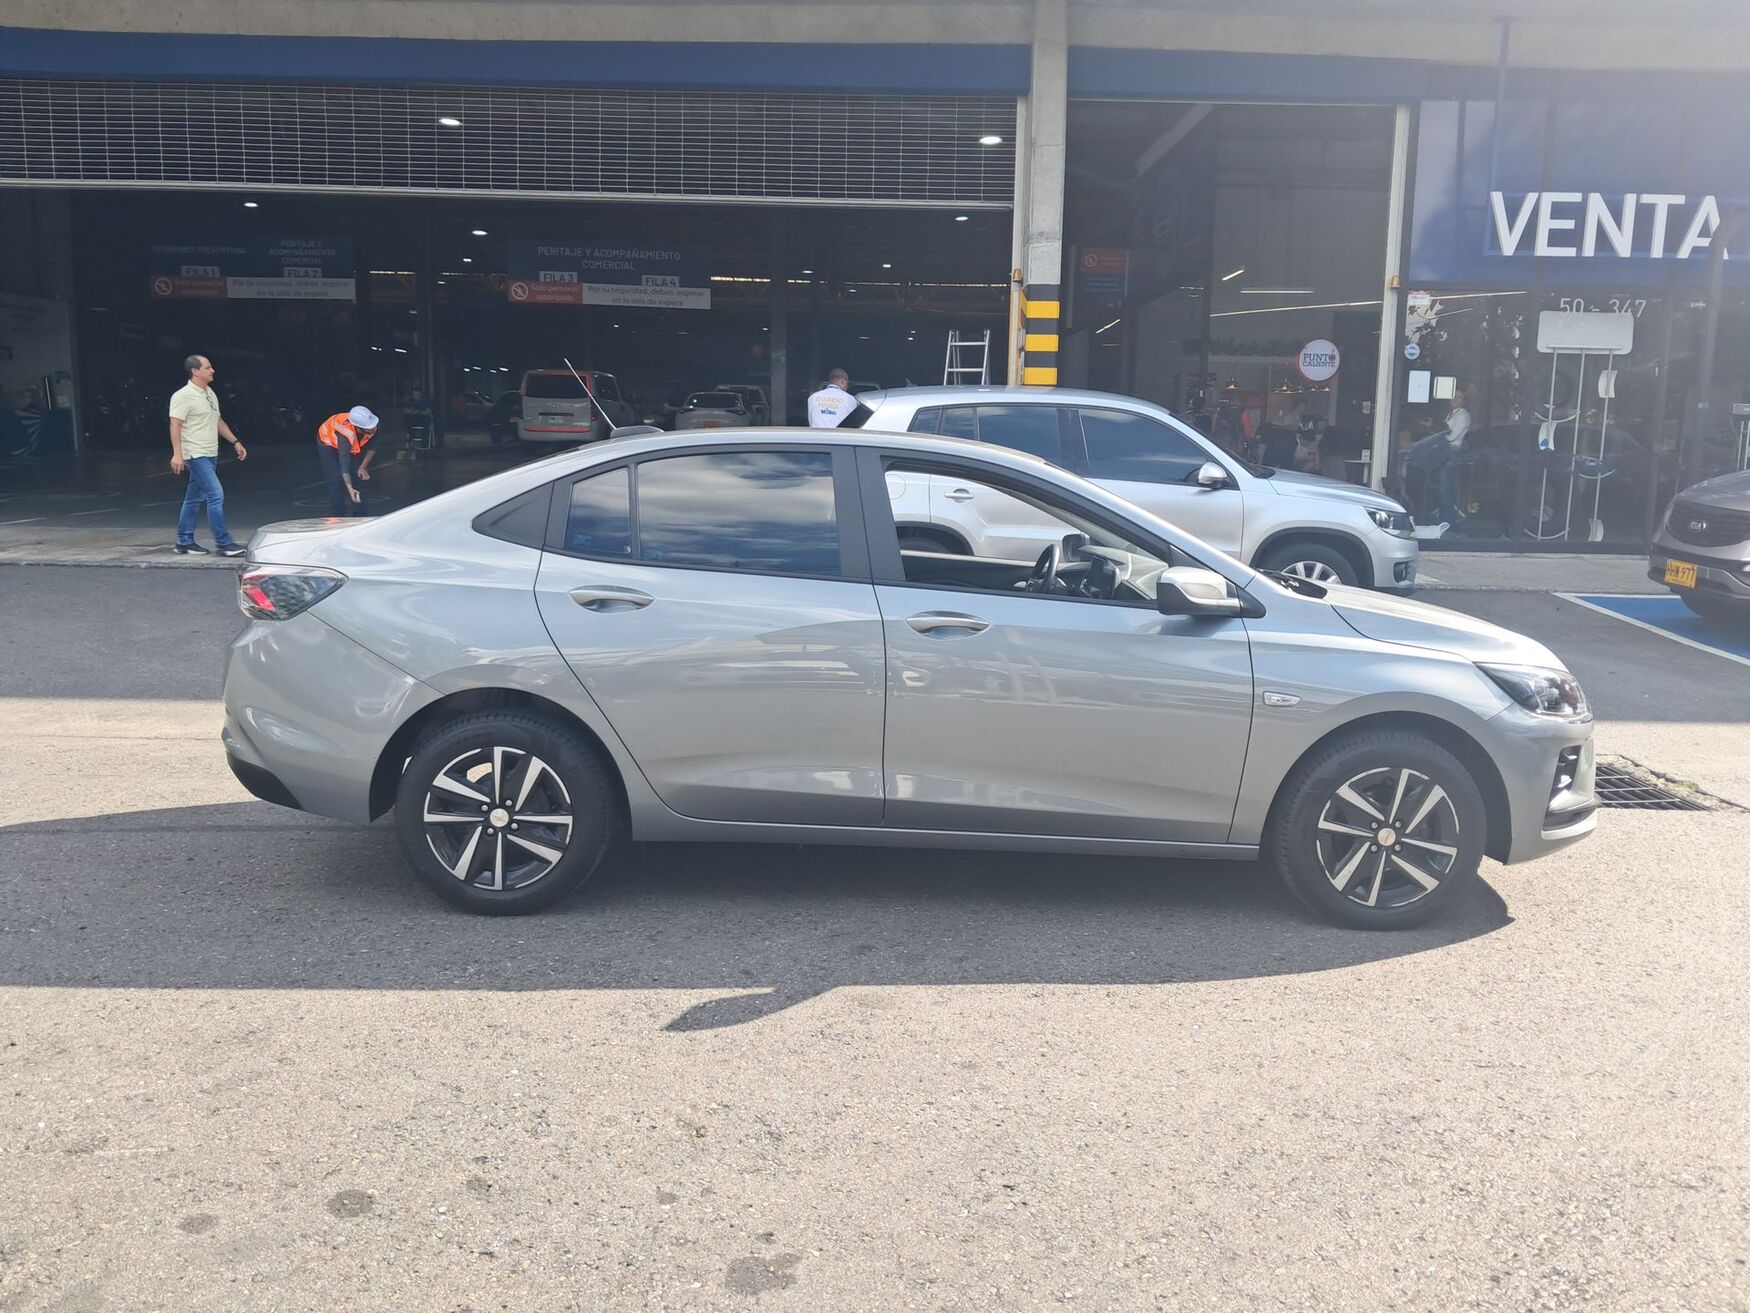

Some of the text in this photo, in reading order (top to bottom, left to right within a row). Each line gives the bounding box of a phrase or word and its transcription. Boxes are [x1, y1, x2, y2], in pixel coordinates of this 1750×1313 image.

[1490, 191, 1729, 260] VENTA
[538, 246, 681, 261] PERITAJE Y ACOMPAÑAMIENTO
[582, 260, 636, 270] COMERCIAL
[186, 267, 210, 277] FILA
[287, 269, 319, 278] FILA 2
[543, 272, 575, 282] FILA 3
[645, 276, 677, 286] FILA 4
[651, 287, 674, 296] debes
[677, 290, 705, 299] esperar
[1560, 298, 1585, 313] 50
[1303, 353, 1336, 361] PUNTO
[1681, 567, 1697, 582] 977
